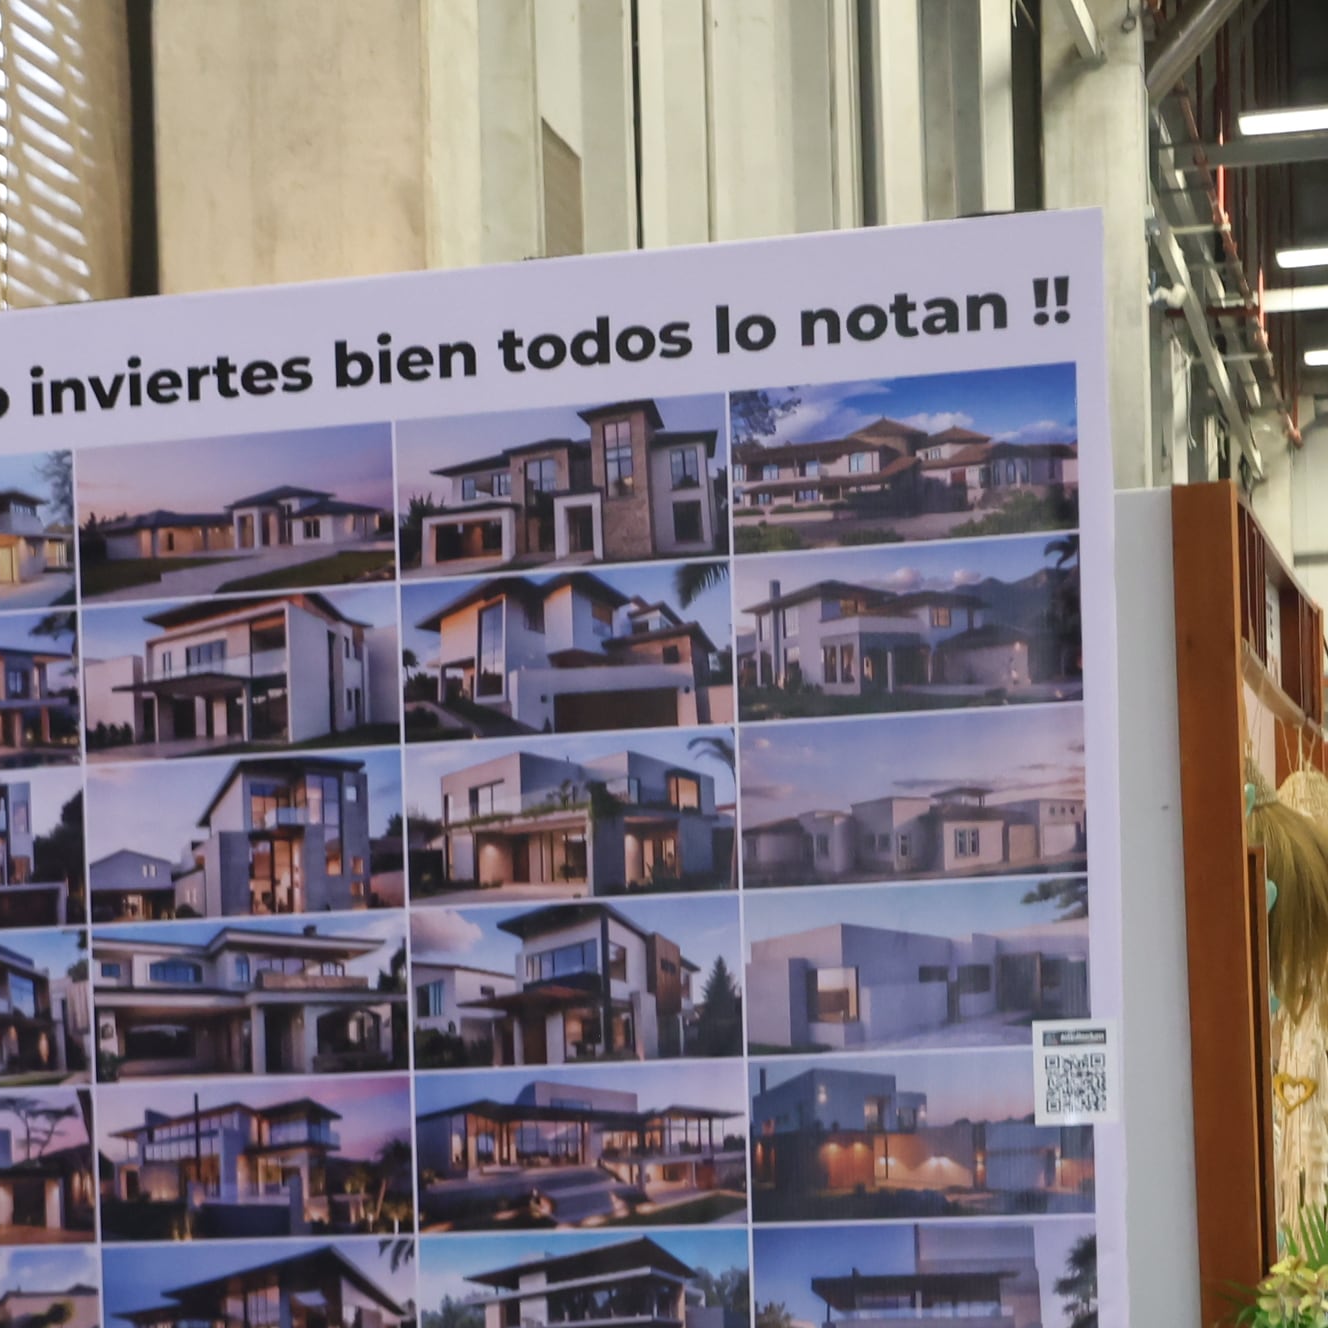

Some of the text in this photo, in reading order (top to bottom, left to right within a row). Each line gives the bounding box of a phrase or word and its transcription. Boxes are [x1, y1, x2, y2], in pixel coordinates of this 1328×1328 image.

[30, 356, 313, 416] inviertes
[334, 332, 477, 388] bien
[497, 315, 693, 373] todos
[715, 304, 776, 354] lo
[800, 292, 1008, 346] notan
[1032, 275, 1070, 326] !!
